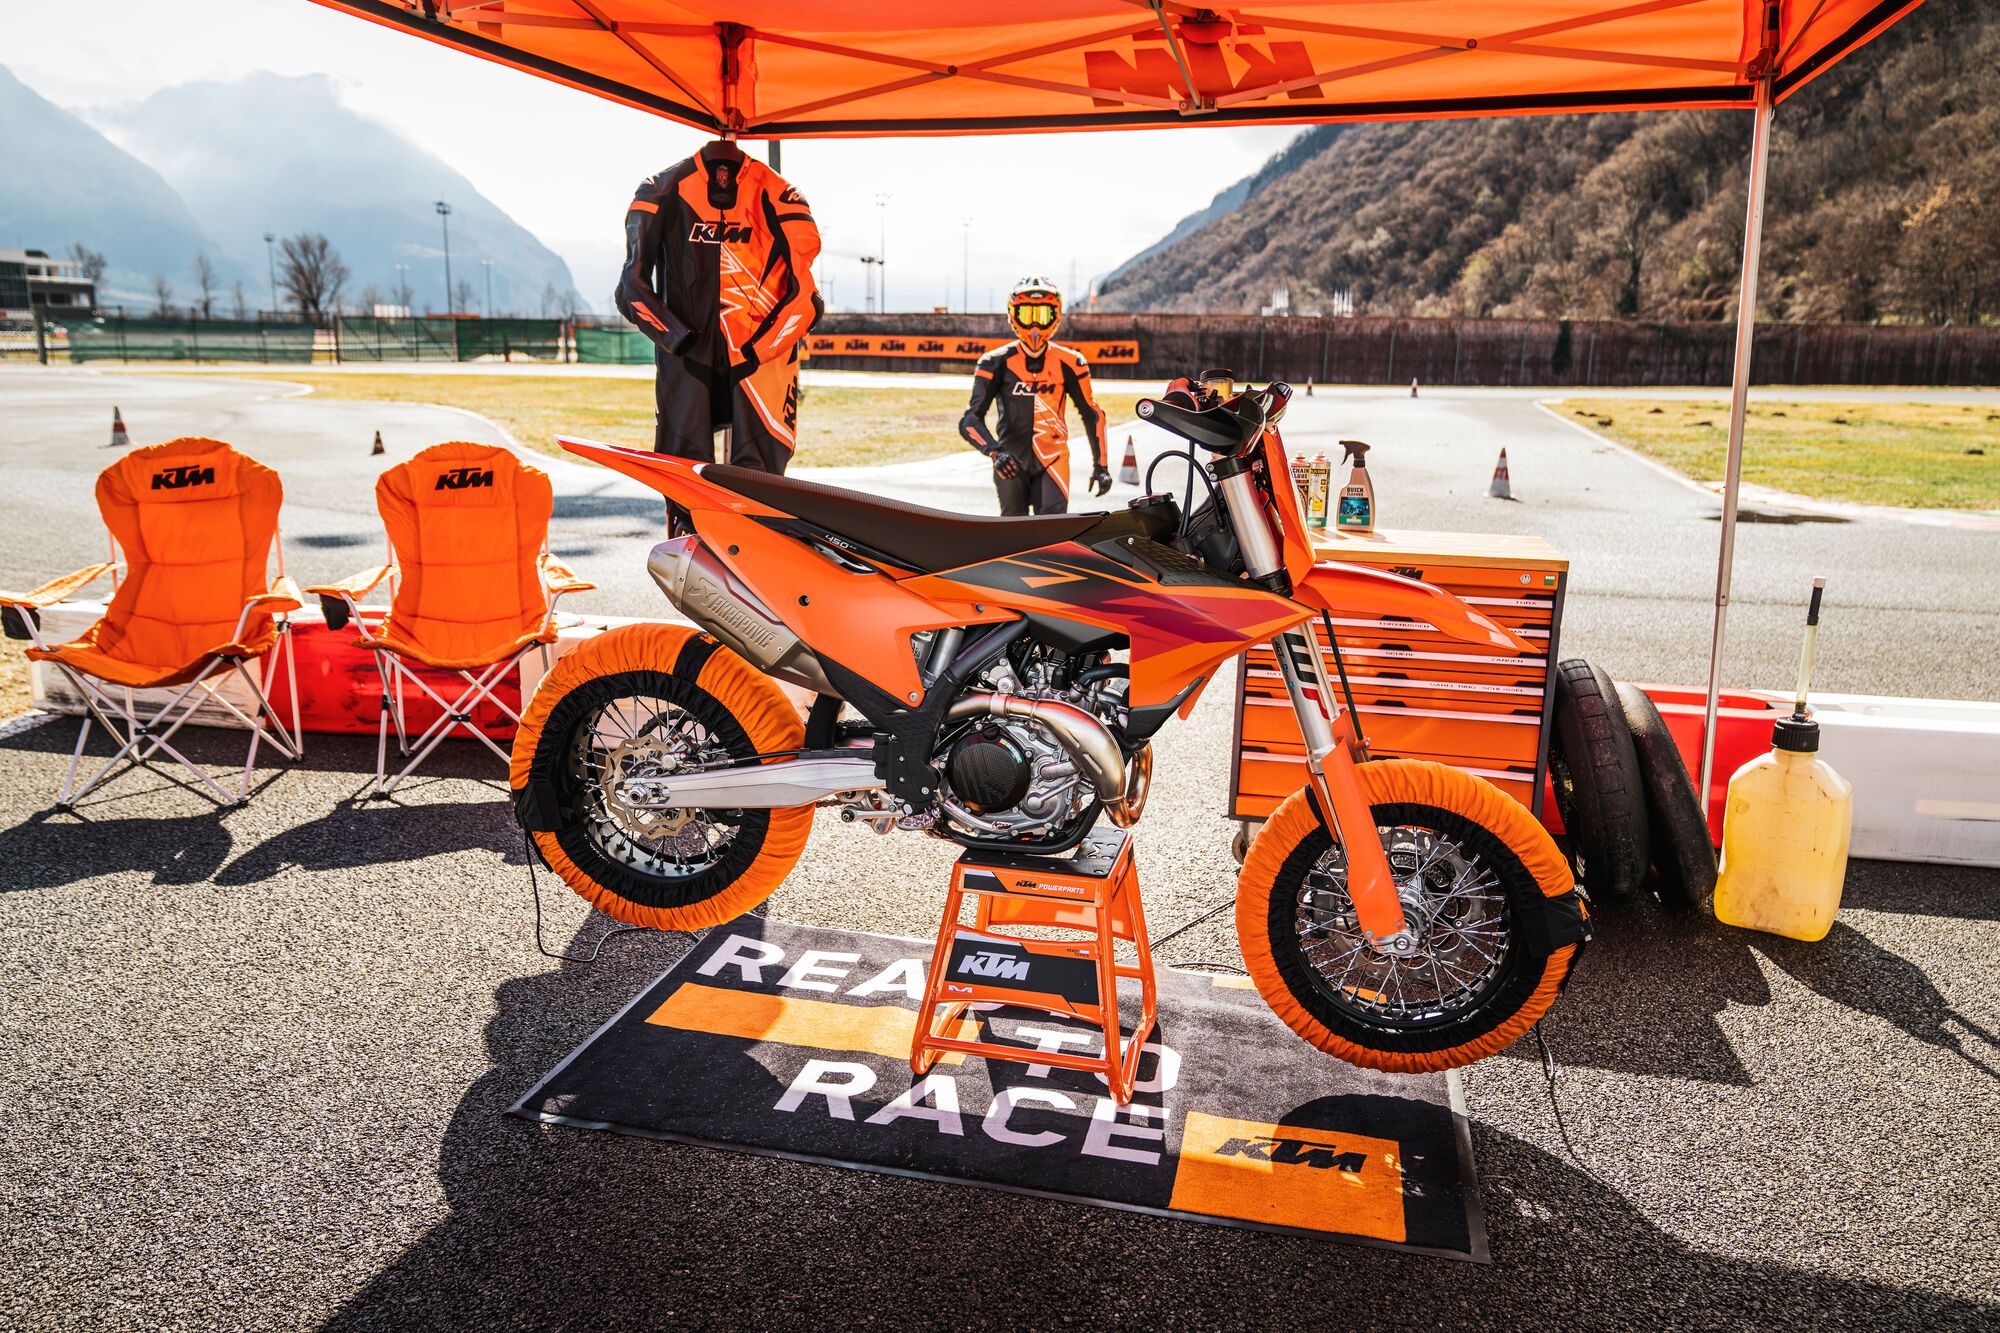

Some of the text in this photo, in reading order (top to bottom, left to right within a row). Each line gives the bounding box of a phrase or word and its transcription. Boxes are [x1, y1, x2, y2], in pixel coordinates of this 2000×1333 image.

[688, 220, 752, 244] KTM
[813, 339, 834, 350] KTM
[845, 339, 869, 350] KTM
[880, 340, 905, 351] KTM
[917, 340, 944, 353] KTM
[956, 341, 986, 354] KTM
[1097, 345, 1135, 358] KTM
[1012, 380, 1056, 396] KTM
[151, 464, 215, 490] KTM
[434, 466, 494, 491] KTM
[824, 534, 850, 549] 450
[957, 951, 1031, 981] KTM
[1015, 1026, 1182, 1094] TO
[773, 1059, 1170, 1166] RACE
[1215, 1135, 1368, 1174] KTM
